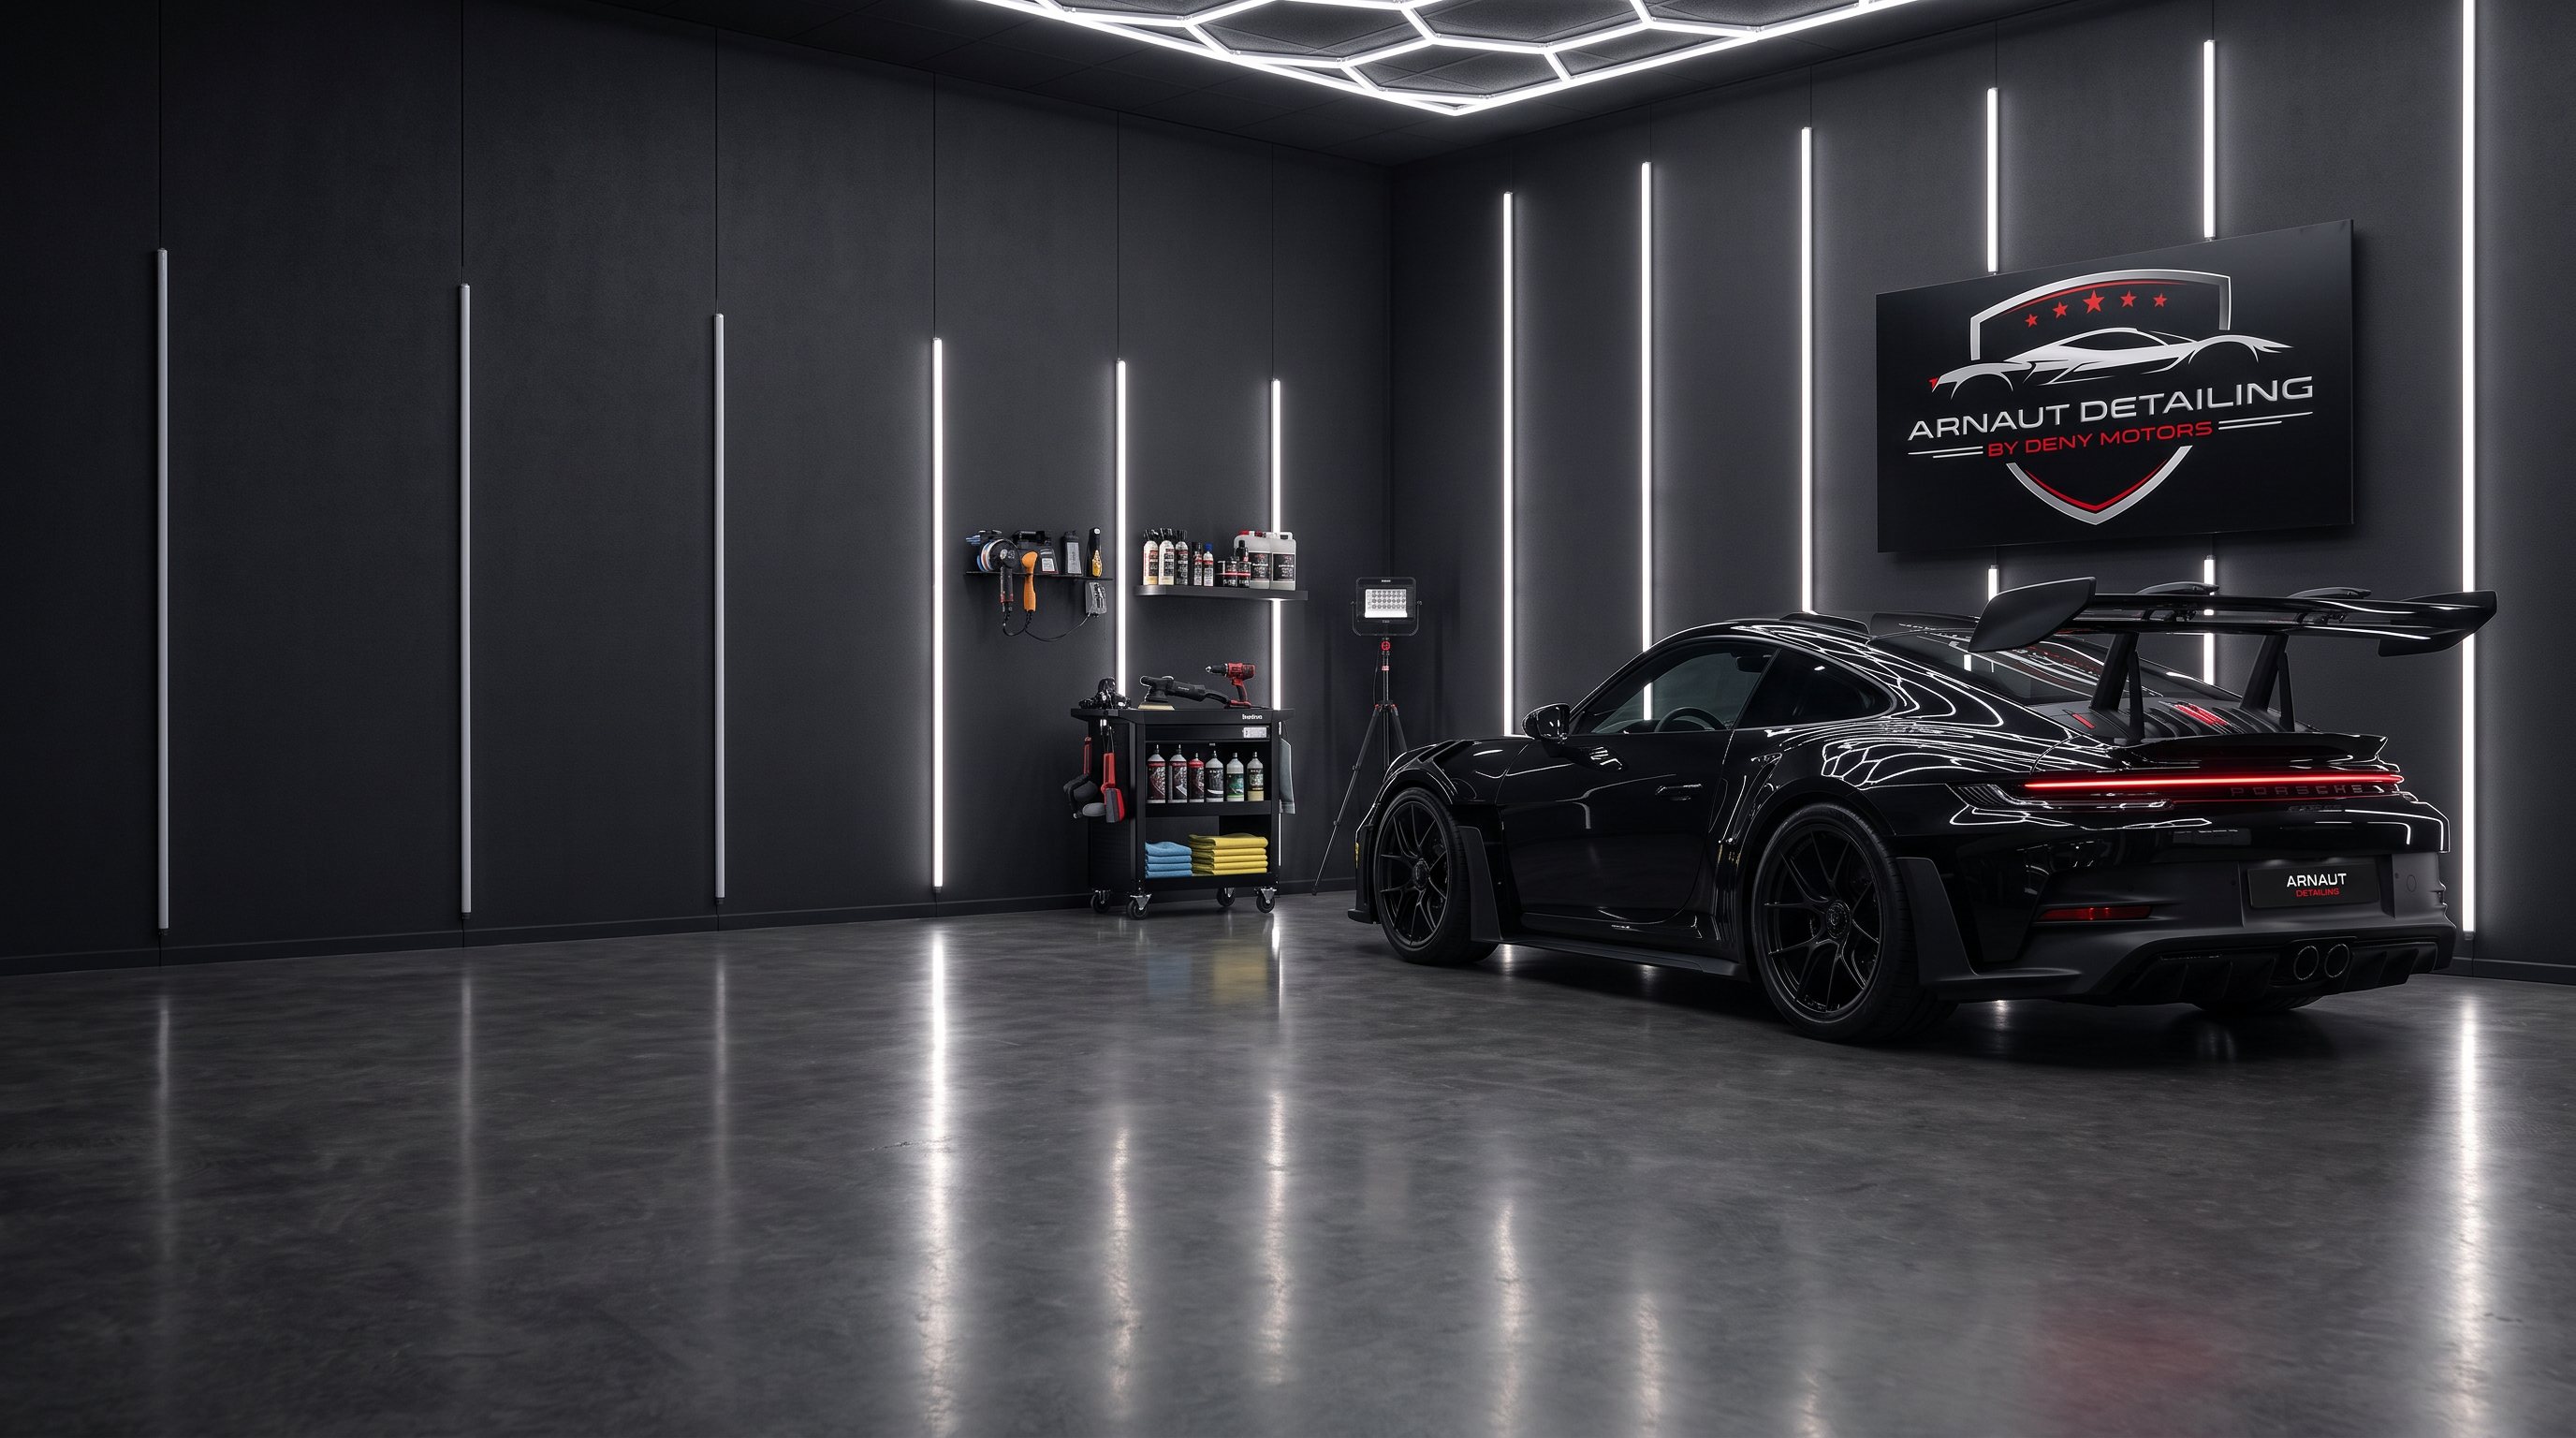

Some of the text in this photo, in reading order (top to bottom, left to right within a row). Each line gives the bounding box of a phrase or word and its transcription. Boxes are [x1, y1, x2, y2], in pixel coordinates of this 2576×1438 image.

[1908, 375, 2313, 441] ARNAUT DETAILING
[1988, 421, 2213, 457] BY DENY MOTORS
[2231, 784, 2364, 797] PORSCHE
[2286, 873, 2347, 888] ARNAUT
[2296, 888, 2340, 897] DETAILING
